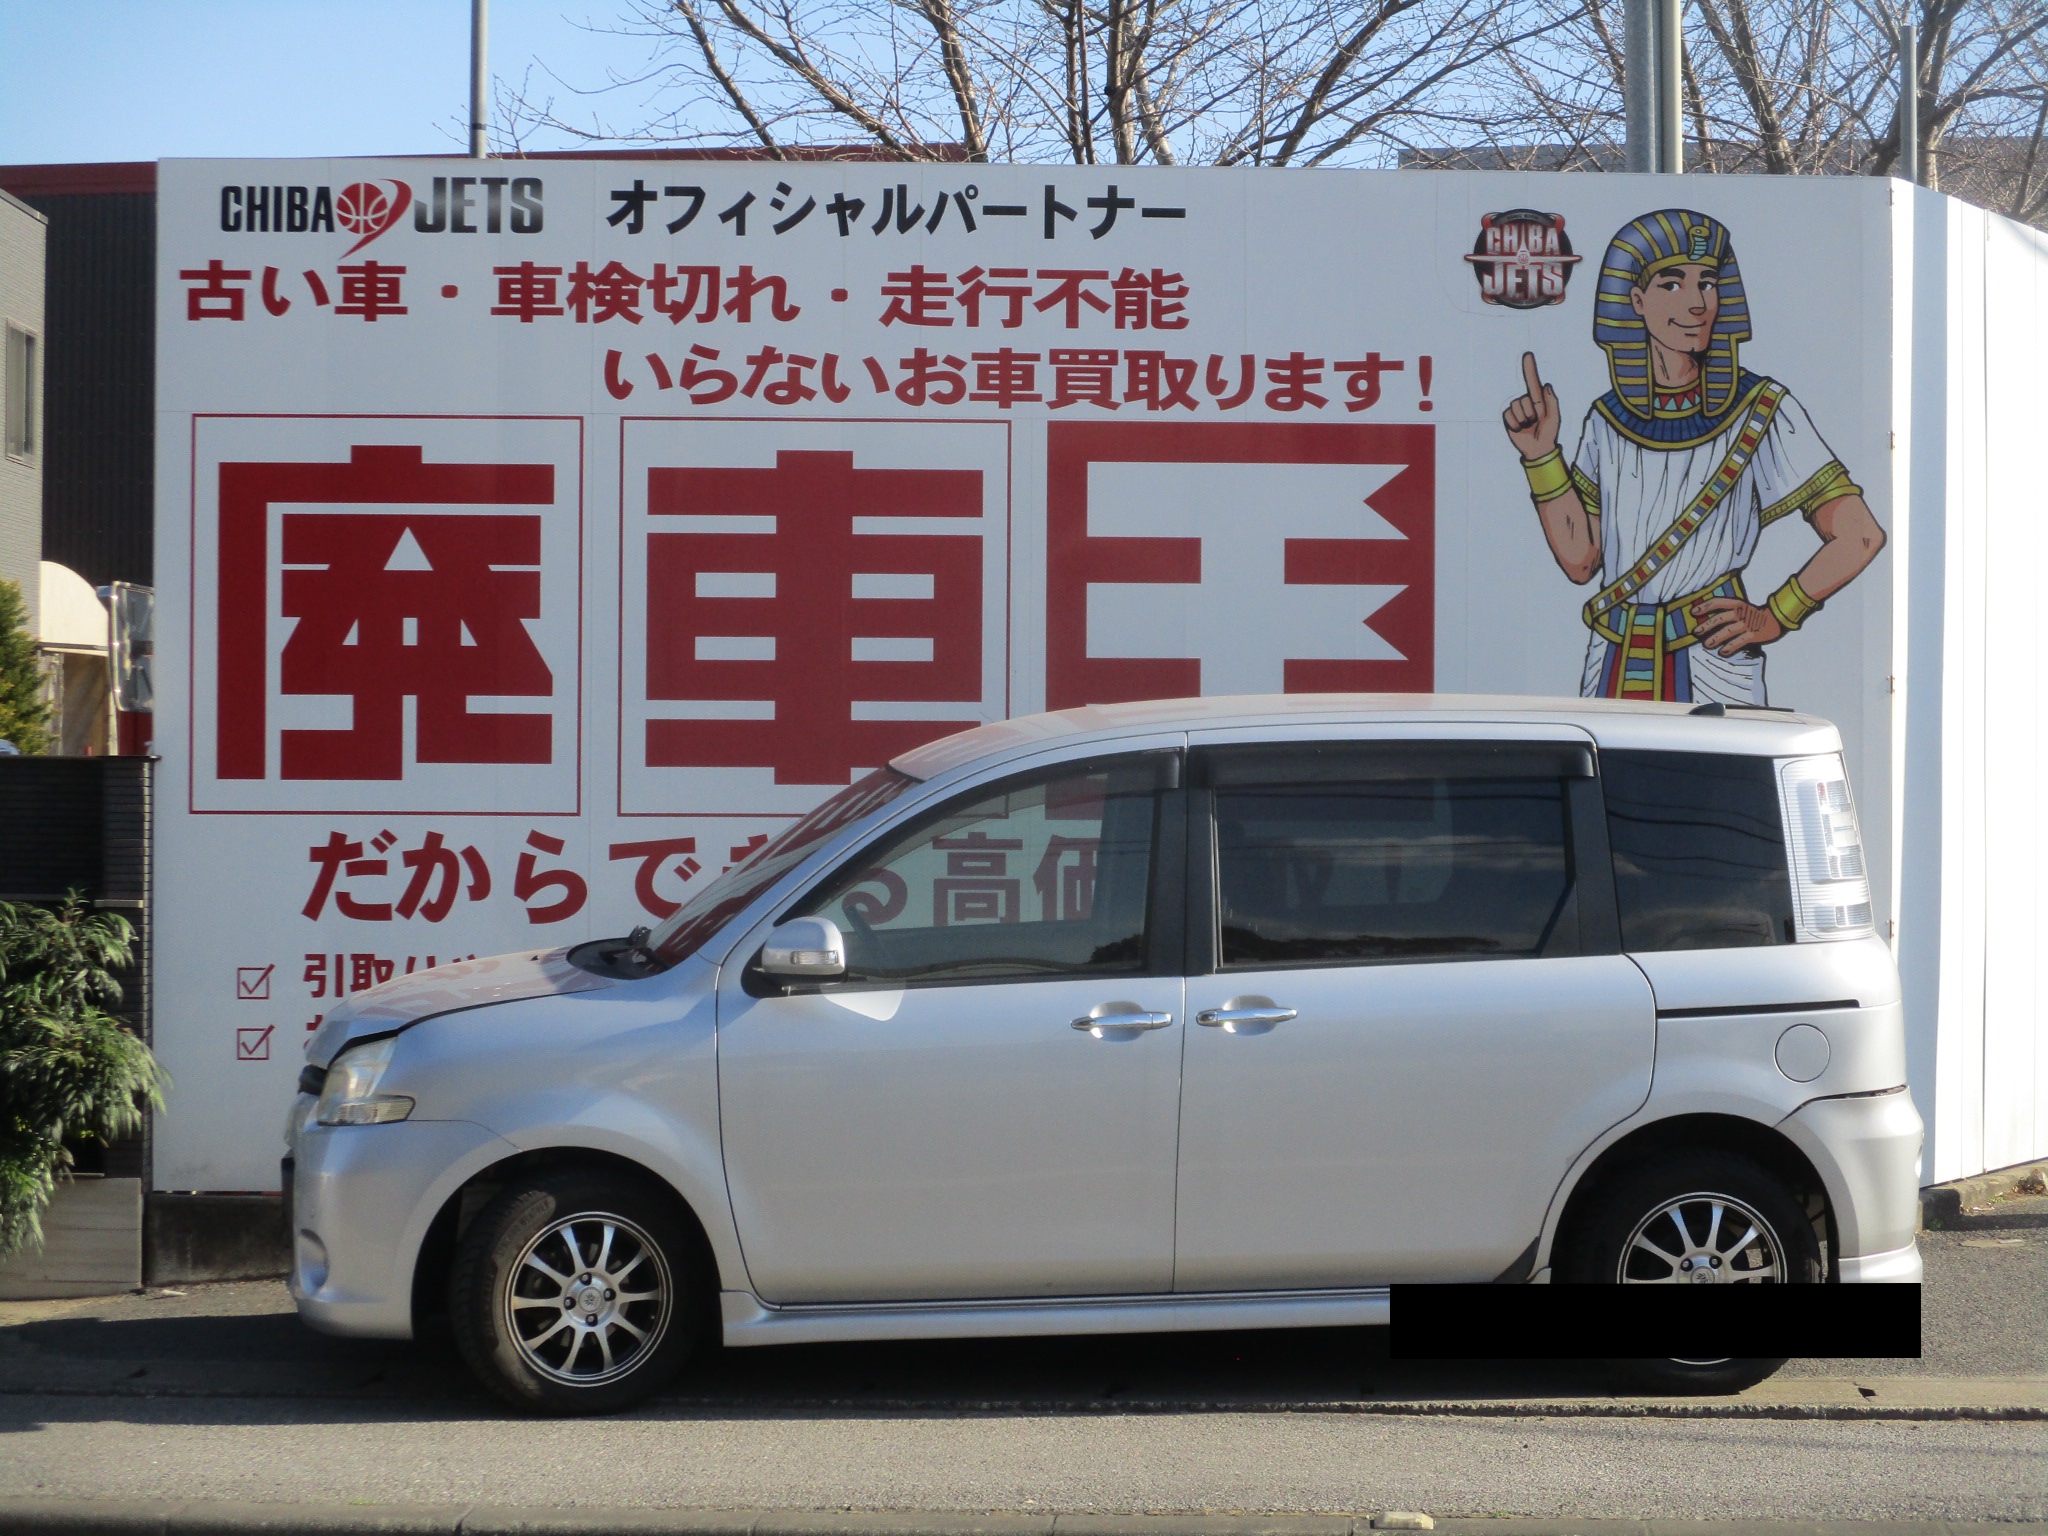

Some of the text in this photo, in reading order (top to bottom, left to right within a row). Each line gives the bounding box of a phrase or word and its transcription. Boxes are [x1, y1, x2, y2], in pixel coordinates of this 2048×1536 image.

[221, 177, 543, 235] CHIBA JETS
[606, 179, 1187, 240] オフィシャルパートナー
[1483, 260, 1563, 299] JETS
